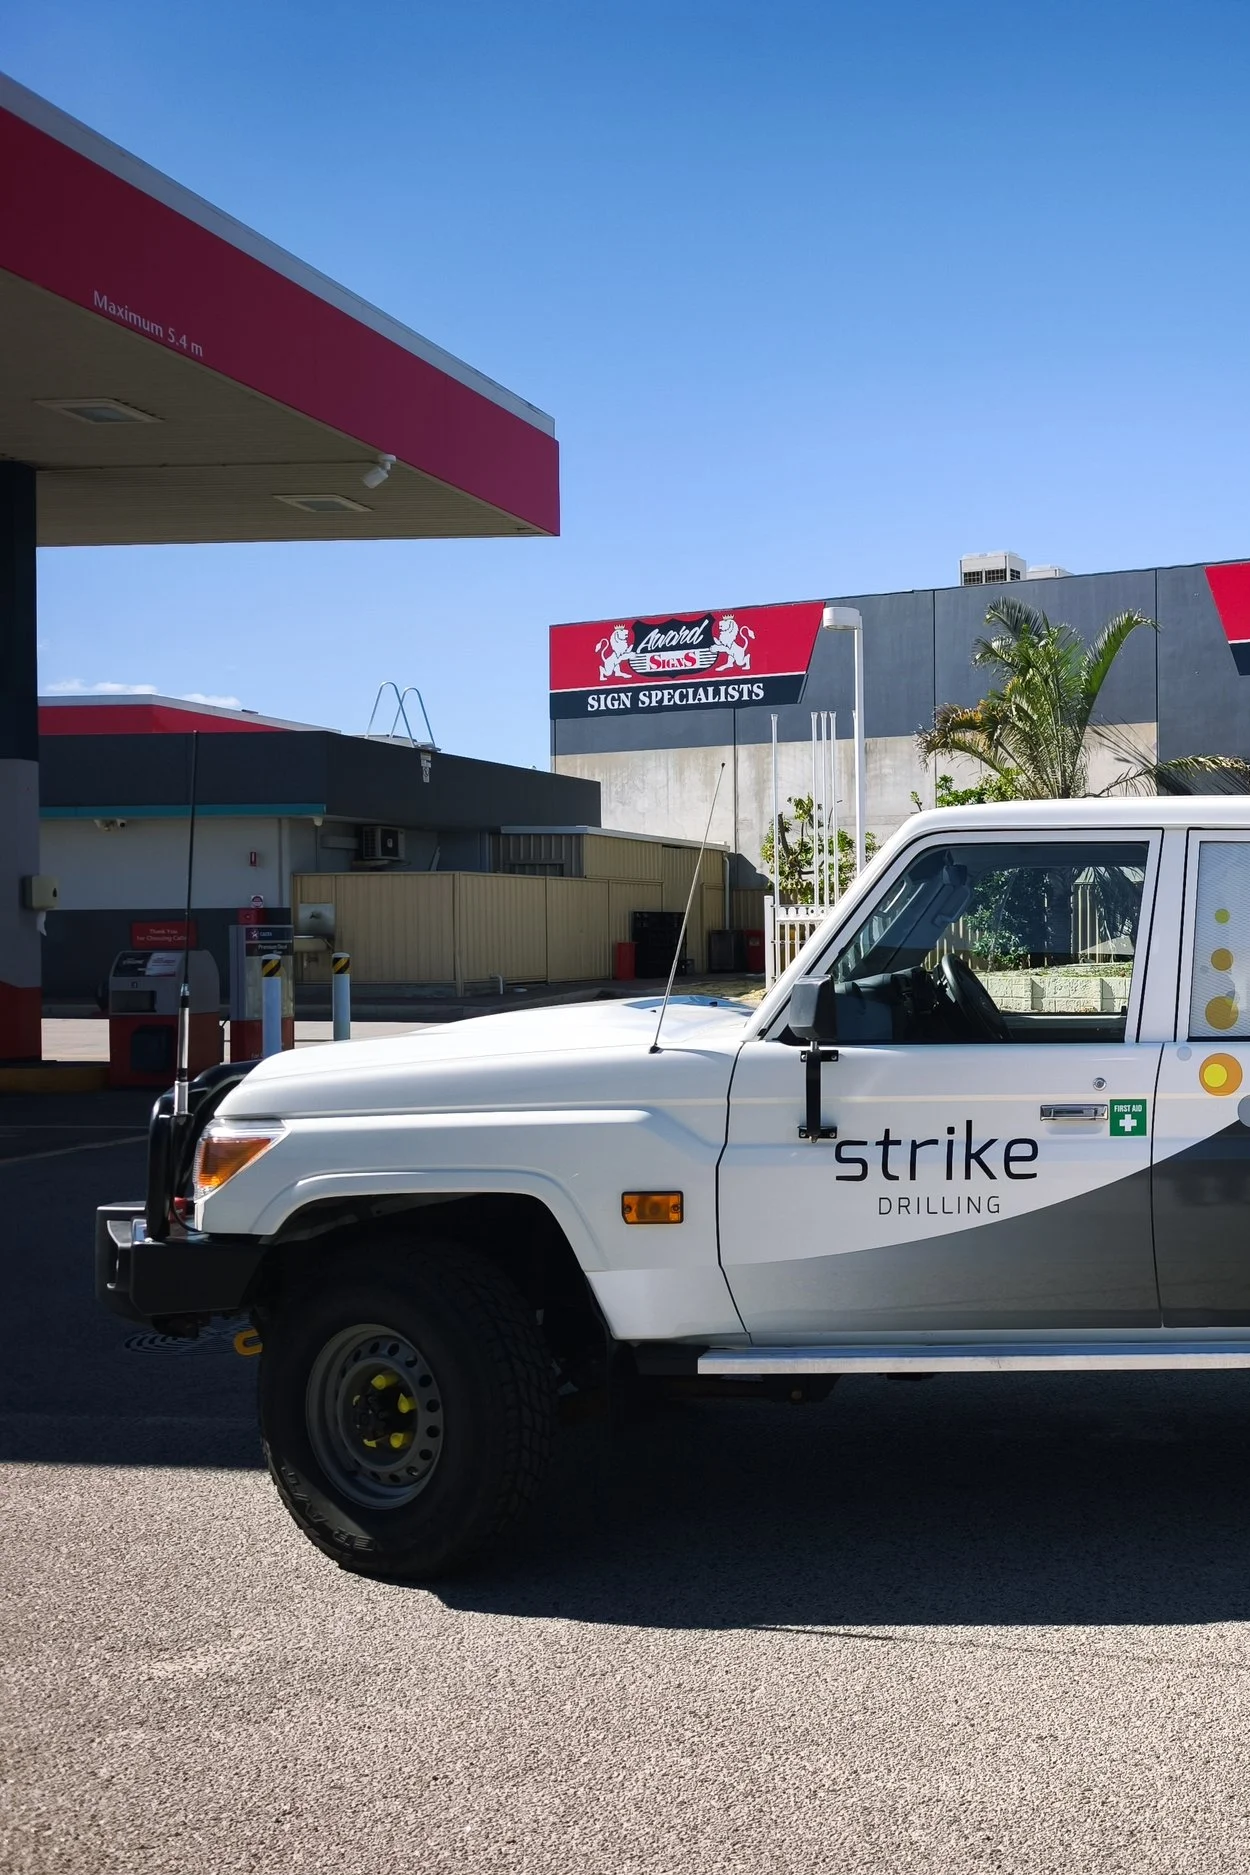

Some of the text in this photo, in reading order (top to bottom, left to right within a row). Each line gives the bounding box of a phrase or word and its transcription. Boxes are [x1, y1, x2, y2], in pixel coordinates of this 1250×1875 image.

[93, 290, 203, 357] Maximum 5.4 m
[636, 619, 709, 654] Award
[649, 651, 697, 670] SIGNS
[587, 683, 765, 711] SIGN SPECIALISTS
[1113, 1104, 1143, 1113] FIRST AID
[834, 1119, 1039, 1182] strike
[878, 1195, 1000, 1215] DRILLING
